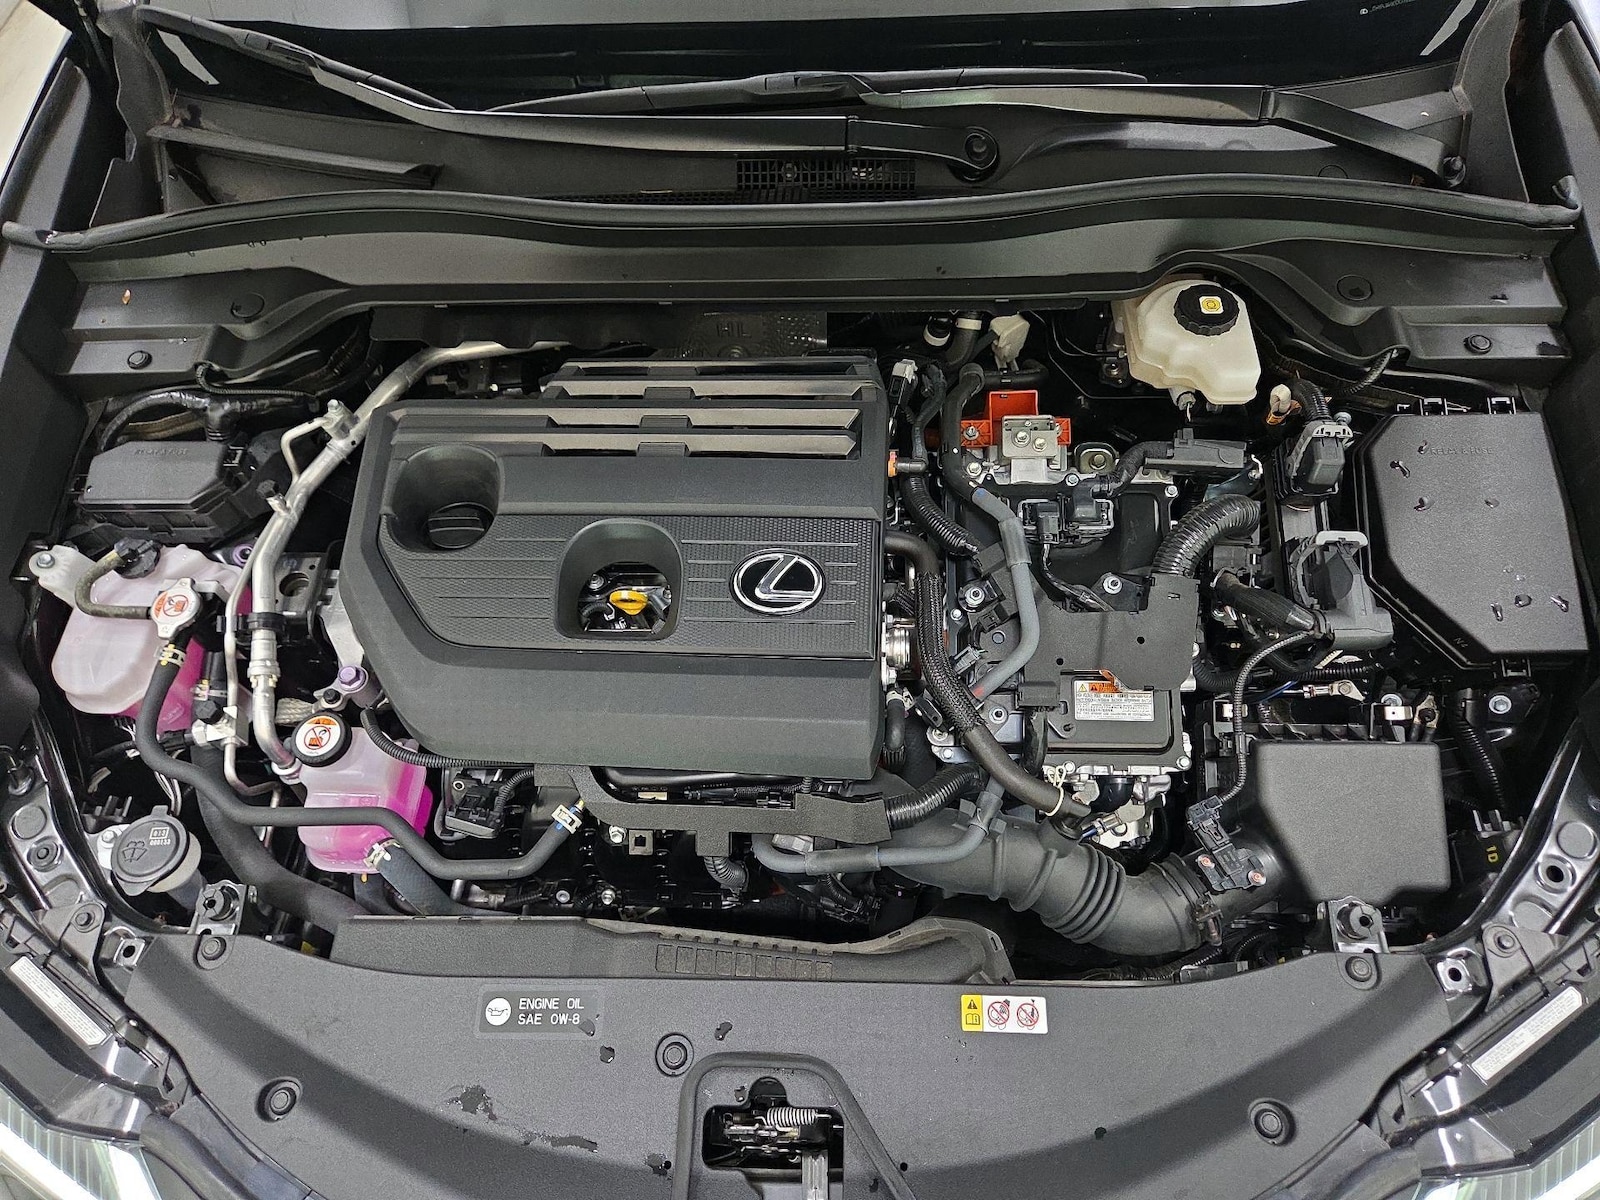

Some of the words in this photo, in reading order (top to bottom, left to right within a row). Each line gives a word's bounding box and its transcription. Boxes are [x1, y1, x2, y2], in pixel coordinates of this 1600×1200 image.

[518, 998, 560, 1010] ENGINE
[566, 998, 584, 1010] OIL
[517, 1013, 543, 1025] SAE
